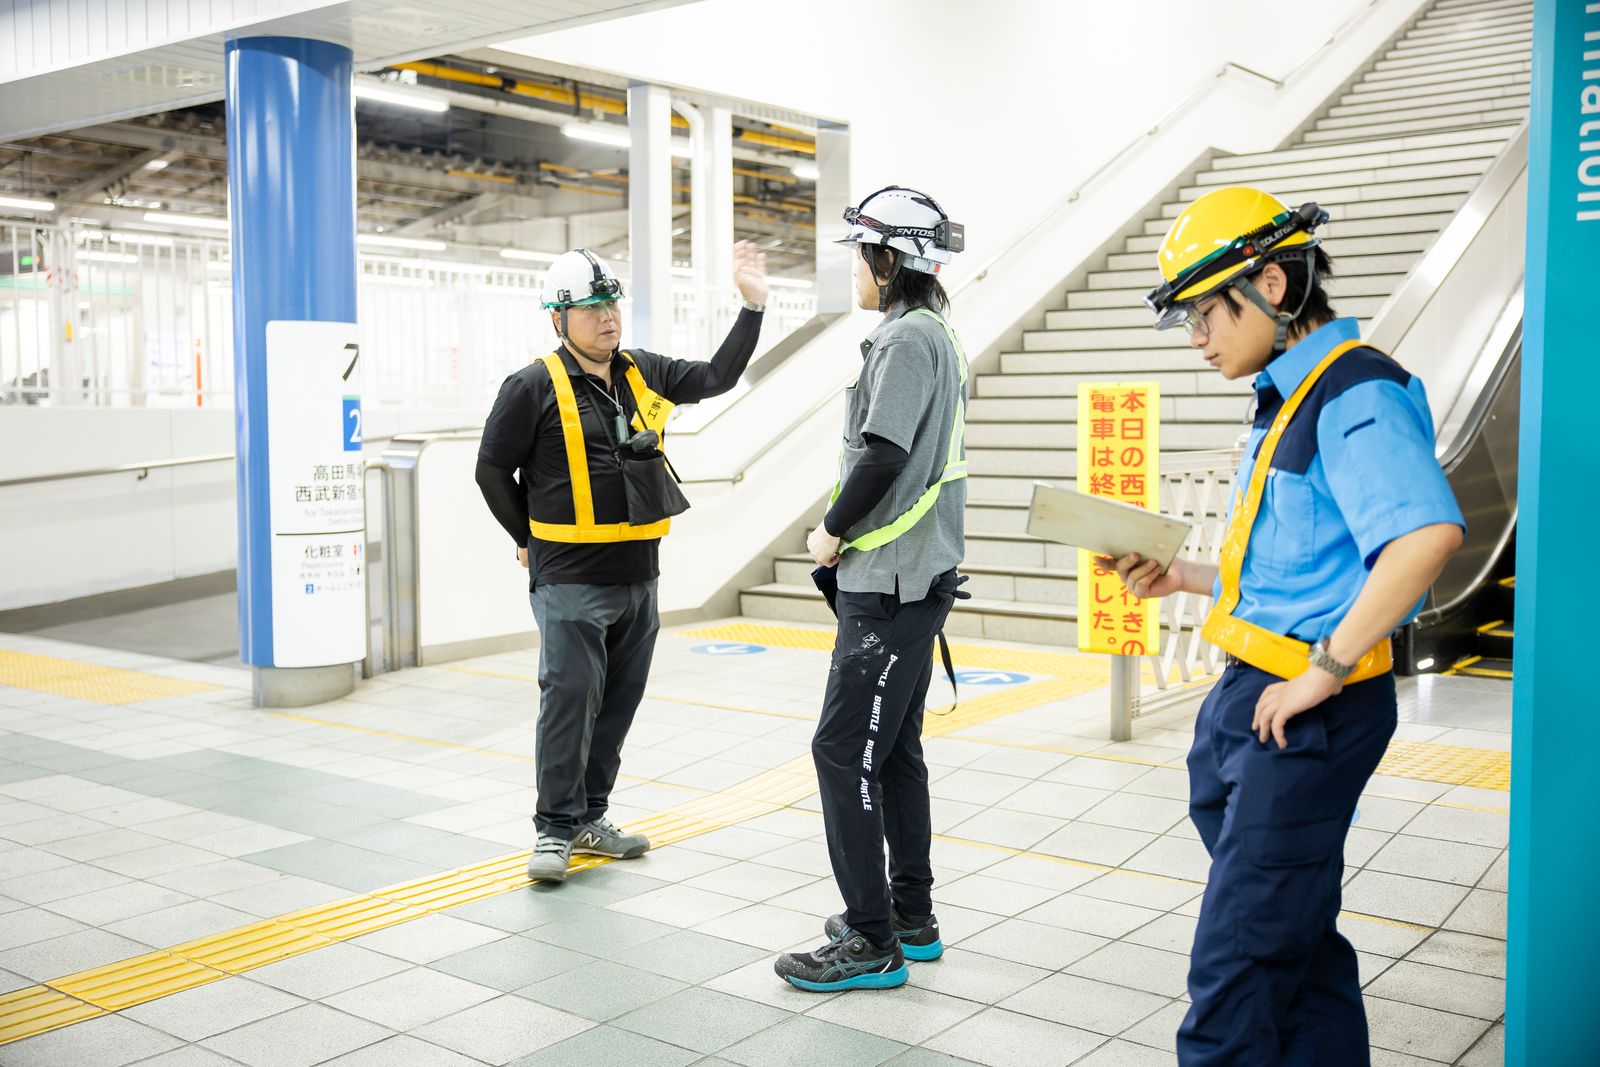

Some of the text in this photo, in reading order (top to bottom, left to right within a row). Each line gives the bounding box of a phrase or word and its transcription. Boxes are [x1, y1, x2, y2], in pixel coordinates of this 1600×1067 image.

[892, 228, 936, 238] ENTOS
[349, 408, 361, 444] 2
[295, 484, 361, 502] 西武新宿
[1090, 390, 1116, 645] 電車は終した。
[1120, 390, 1146, 656] 本日の西行きの
[305, 544, 344, 559] 化粧室
[869, 694, 882, 733] BURTLE
[862, 739, 875, 772] BURTLE
[581, 831, 602, 848] N
